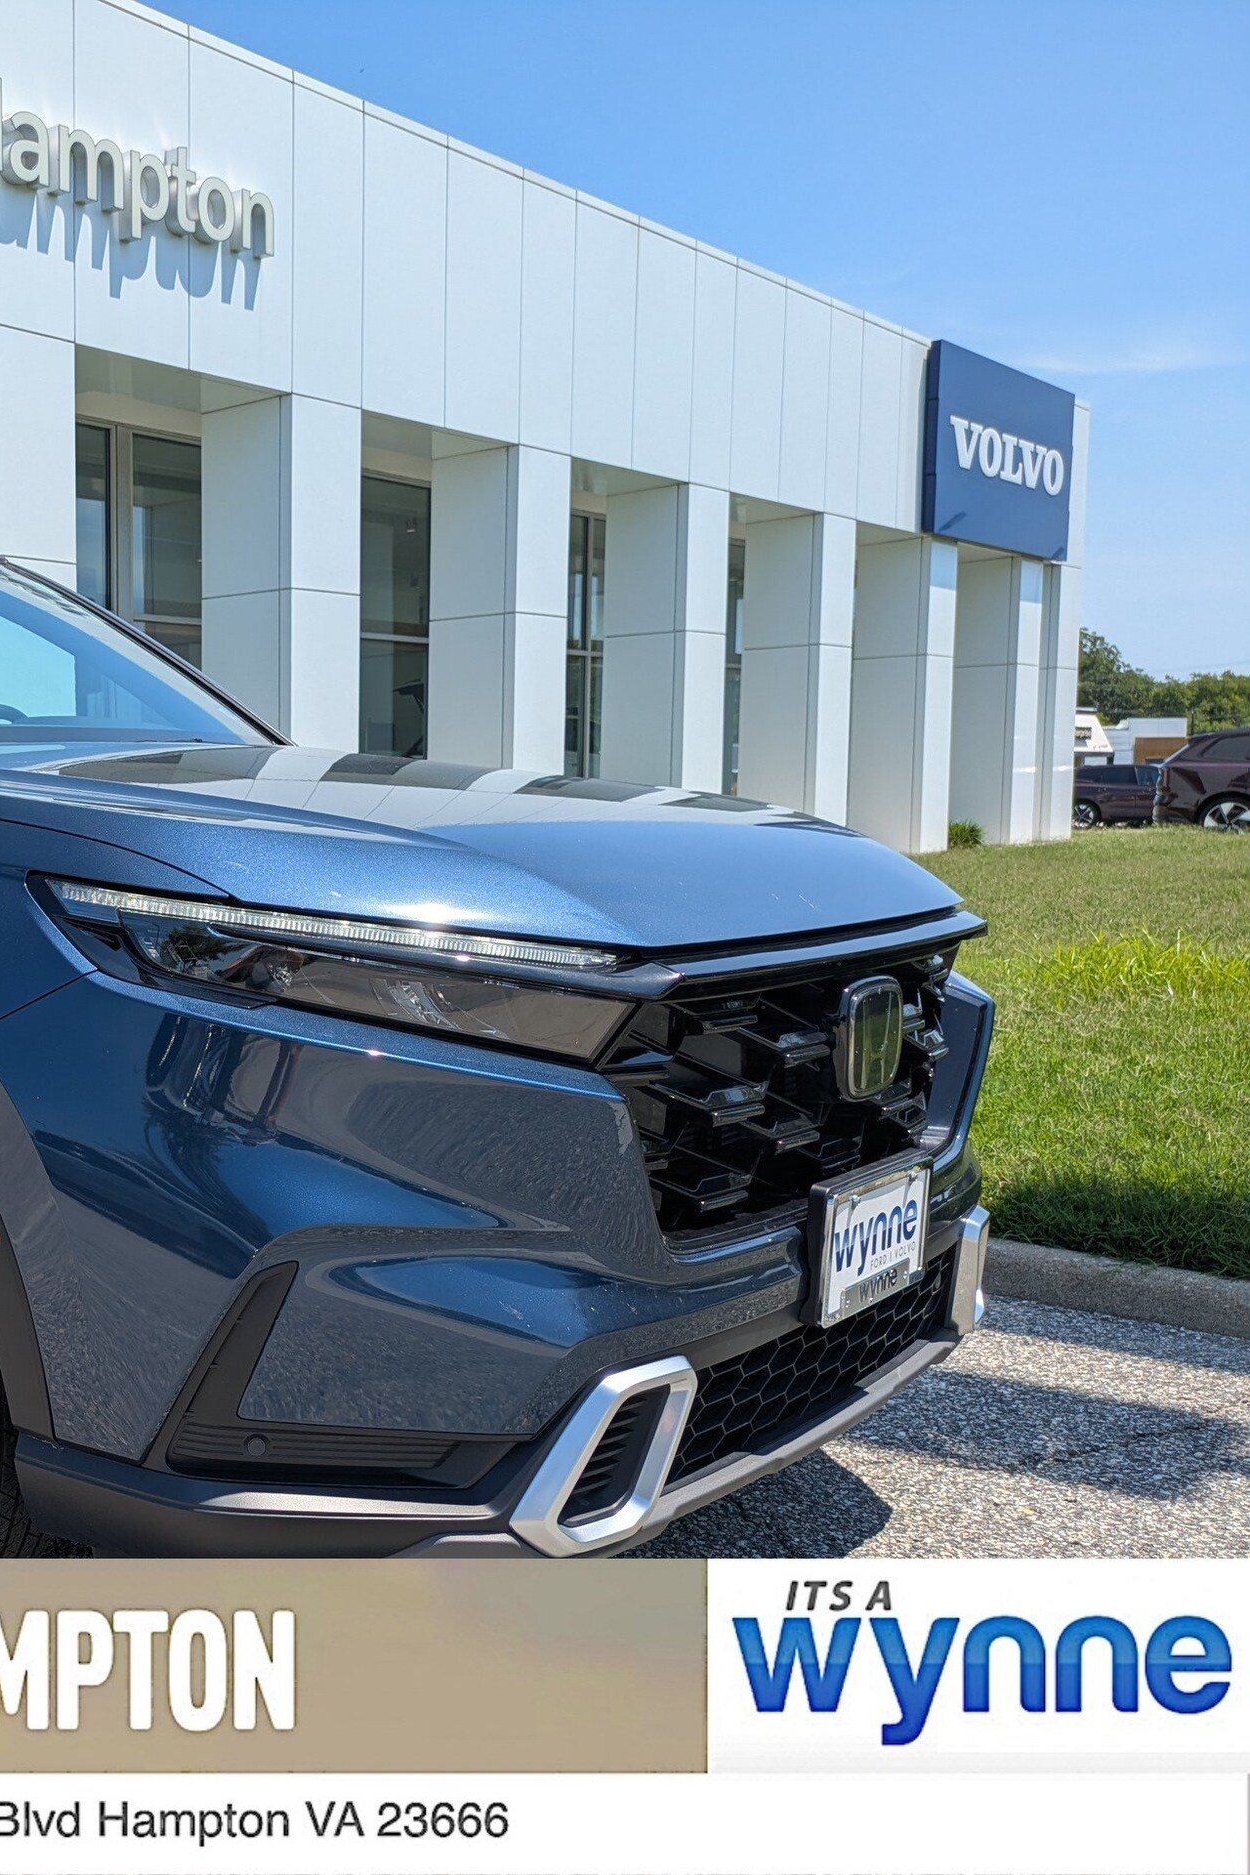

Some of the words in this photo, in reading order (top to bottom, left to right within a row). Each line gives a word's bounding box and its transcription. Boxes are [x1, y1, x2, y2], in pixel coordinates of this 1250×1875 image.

[950, 415, 1065, 496] VOLVO
[834, 1199, 918, 1277] wynne
[870, 1254, 887, 1269] FORD
[894, 1241, 916, 1259] VOLVO
[858, 1268, 897, 1302] wynne
